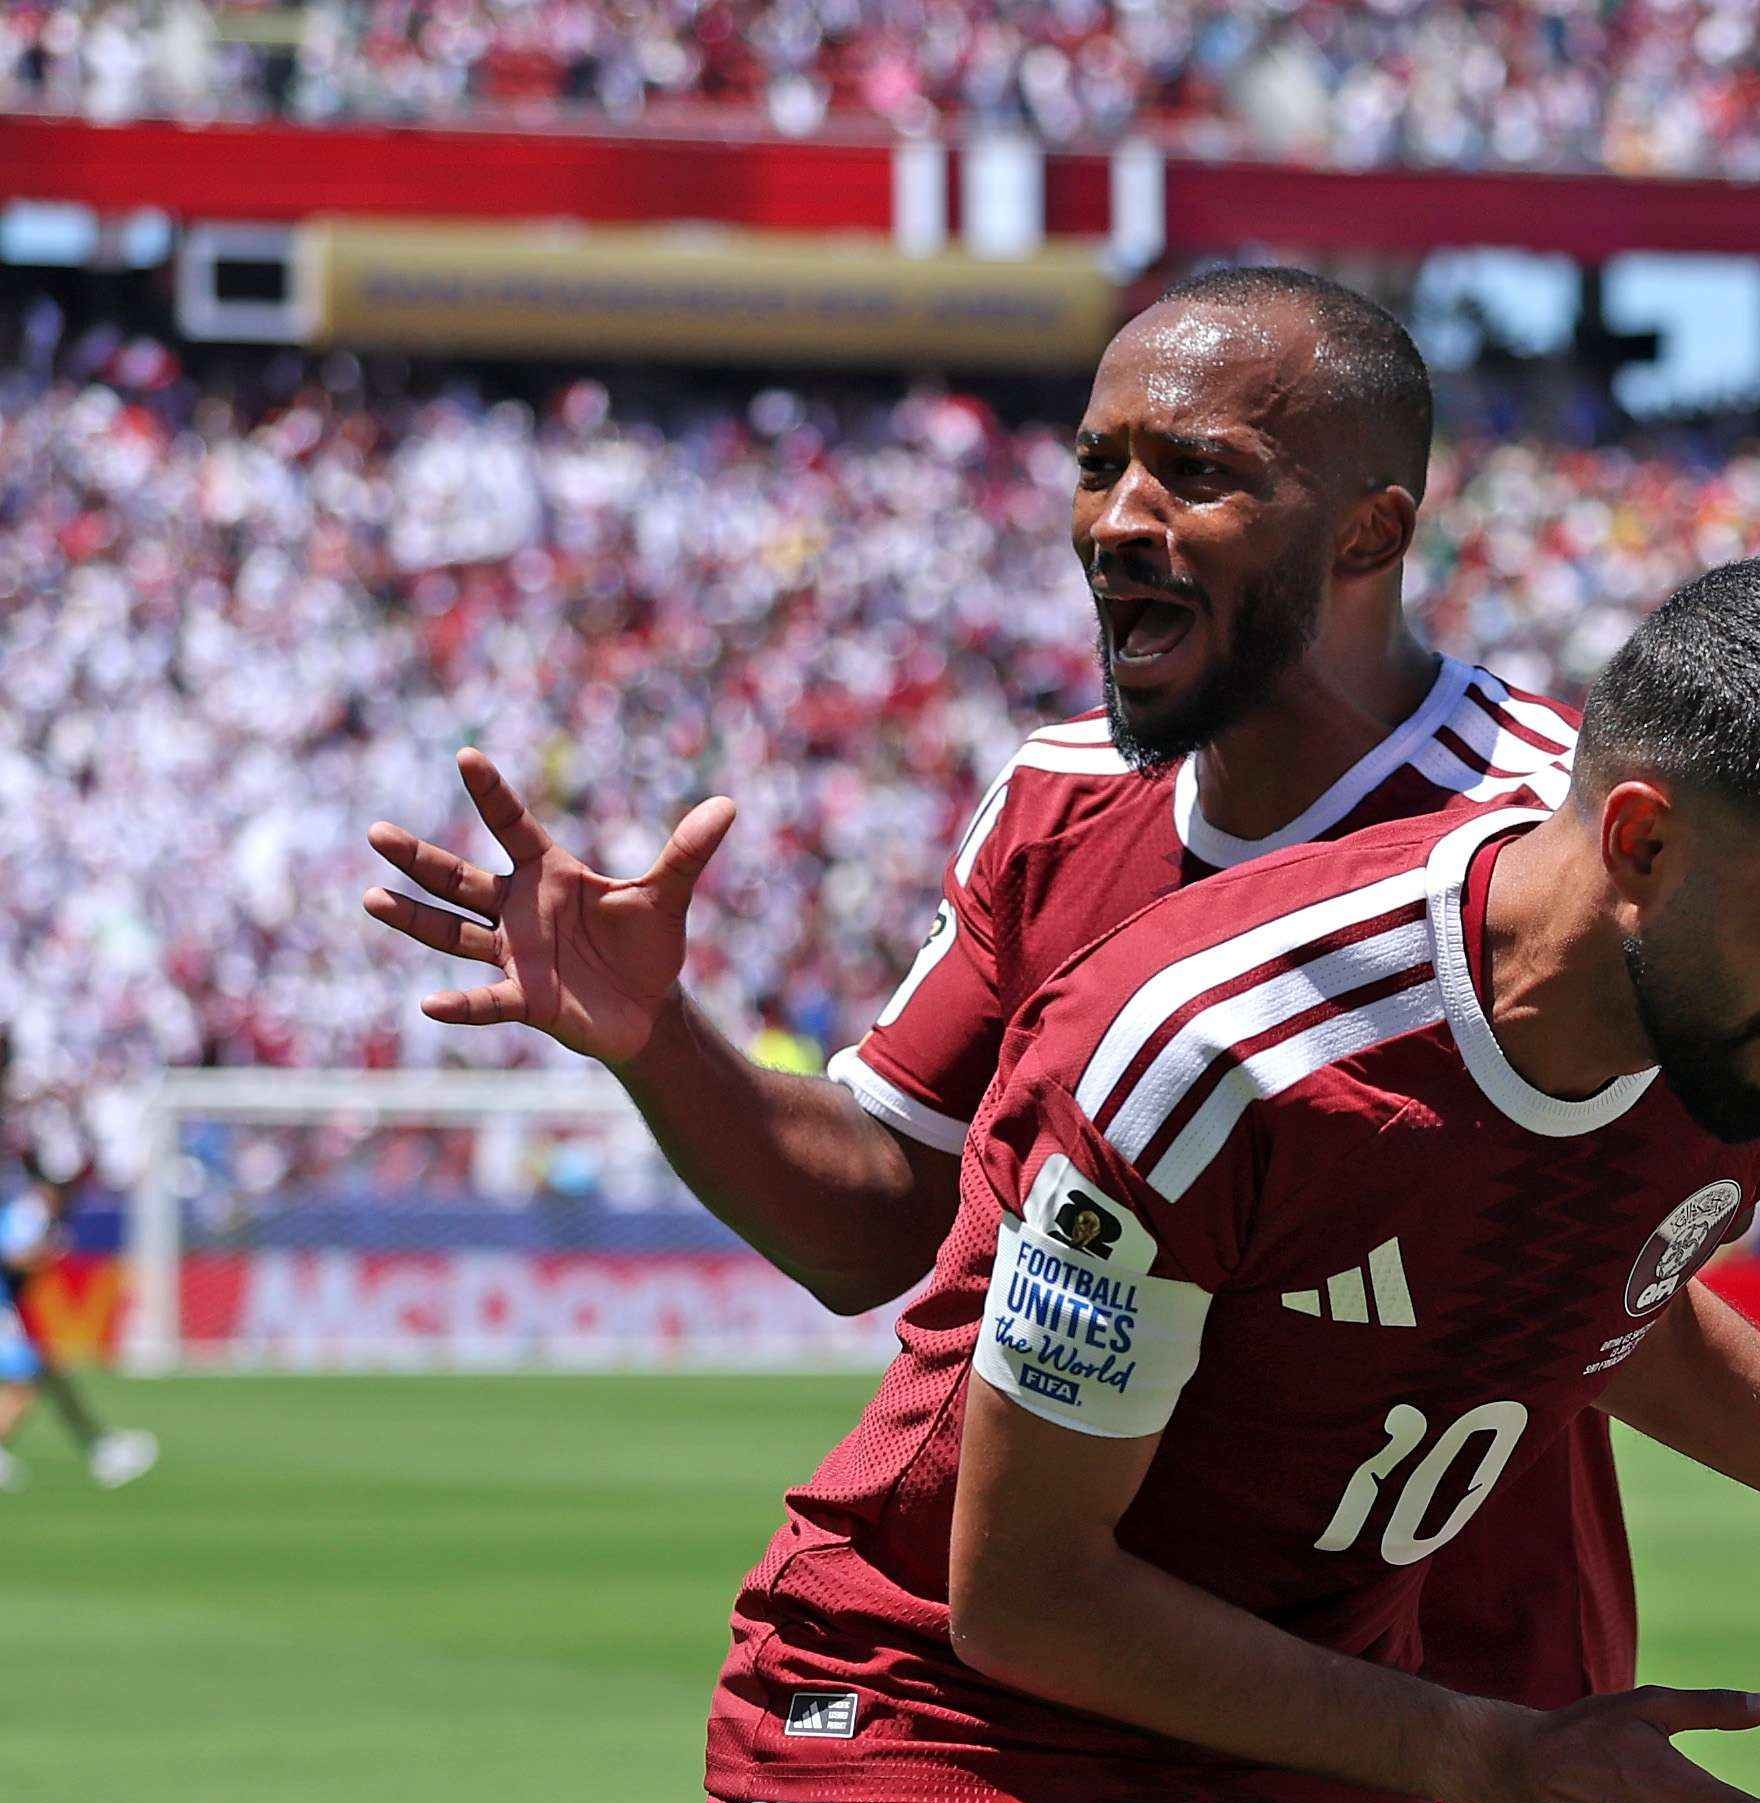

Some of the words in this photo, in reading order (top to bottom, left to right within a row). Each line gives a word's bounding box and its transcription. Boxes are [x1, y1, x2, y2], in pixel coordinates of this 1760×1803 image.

[1006, 1271, 1136, 1354] UNITES
[1015, 1240, 1139, 1314] FOOTBALL
[994, 1315, 1034, 1356] the
[1039, 1334, 1137, 1395] World
[1020, 1366, 1079, 1403] FIFA
[1313, 1400, 1529, 1566] 10
